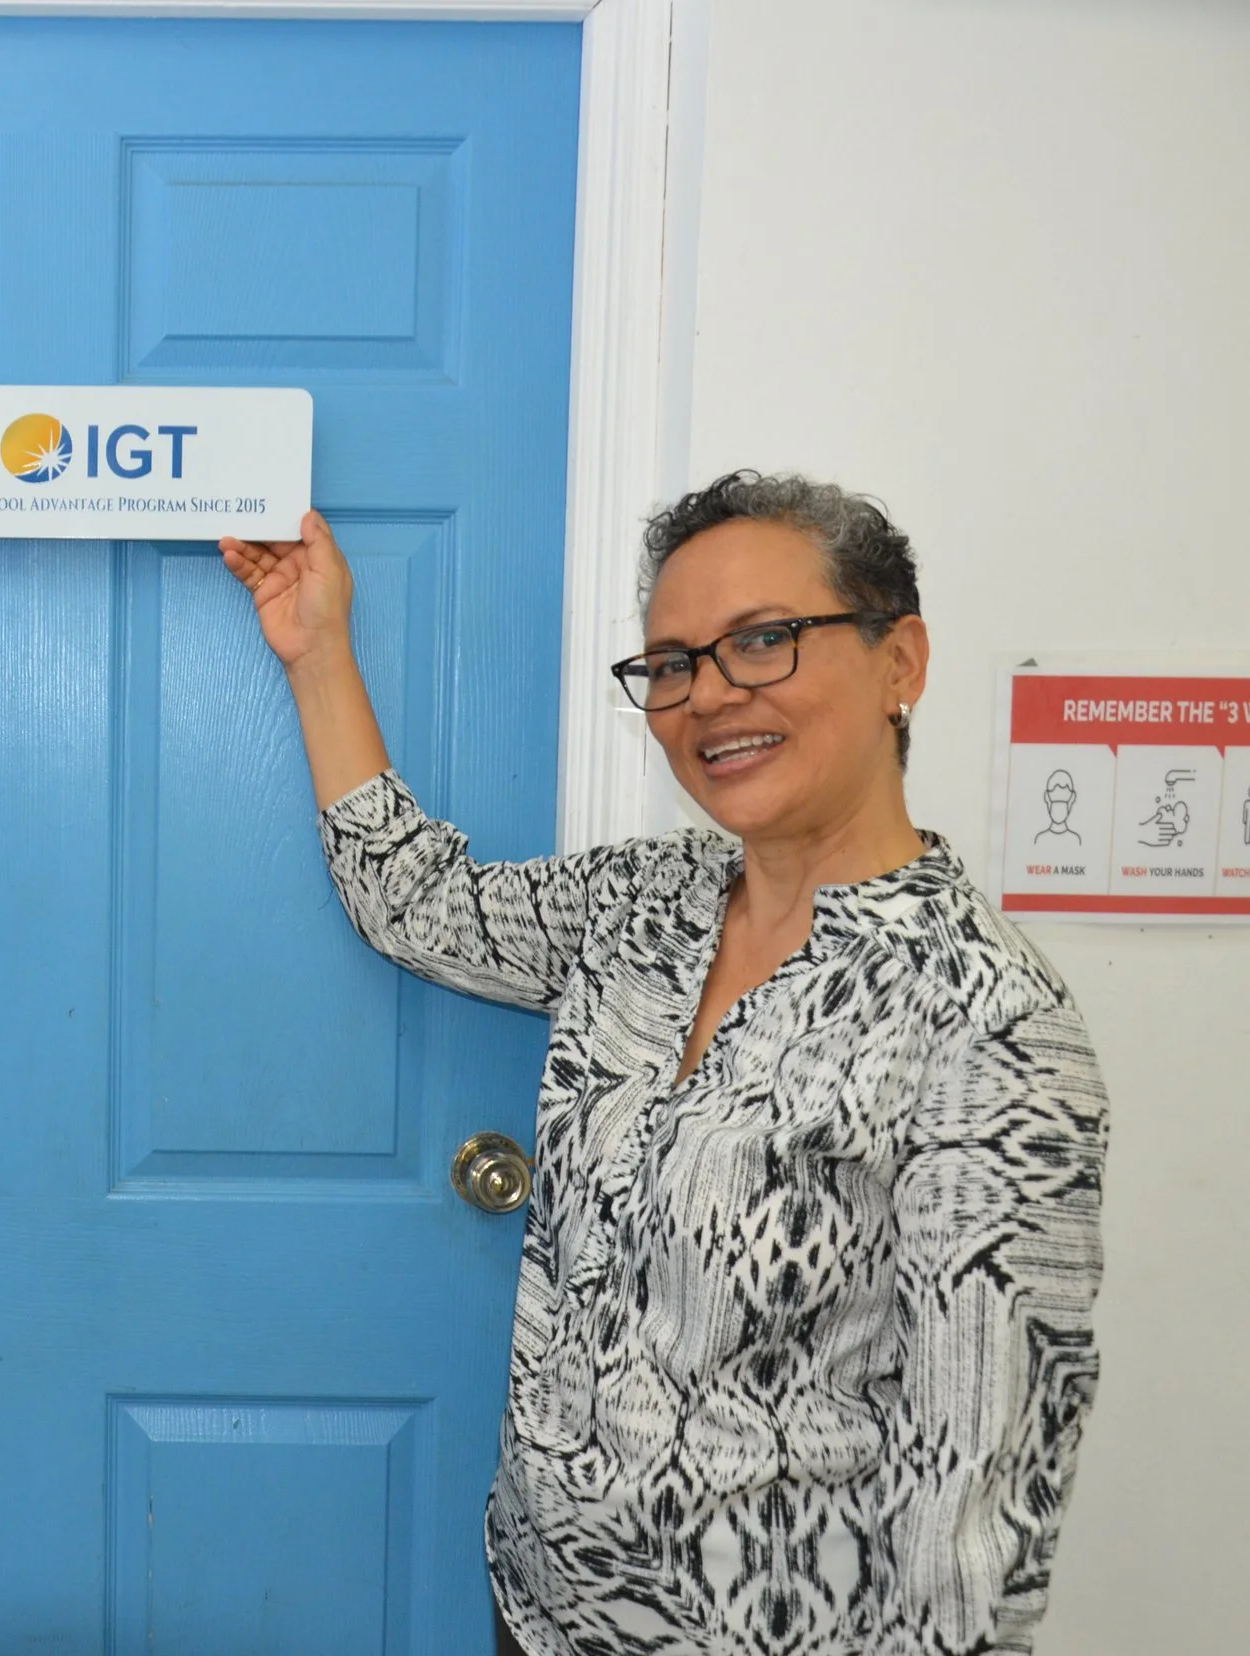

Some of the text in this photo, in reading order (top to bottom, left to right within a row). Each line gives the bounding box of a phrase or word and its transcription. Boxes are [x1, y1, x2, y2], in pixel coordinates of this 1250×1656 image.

[87, 424, 197, 479] IGT
[30, 497, 113, 512] ADVANTAGE
[118, 497, 187, 513] PROGRAM
[191, 498, 232, 513] SINCE
[235, 498, 266, 514] 2015
[1064, 699, 1173, 722] REMEMBER
[1177, 701, 1214, 723] THE
[1026, 865, 1086, 875] WEAR A MASK
[1121, 866, 1204, 877] WASH YOUR HANDS
